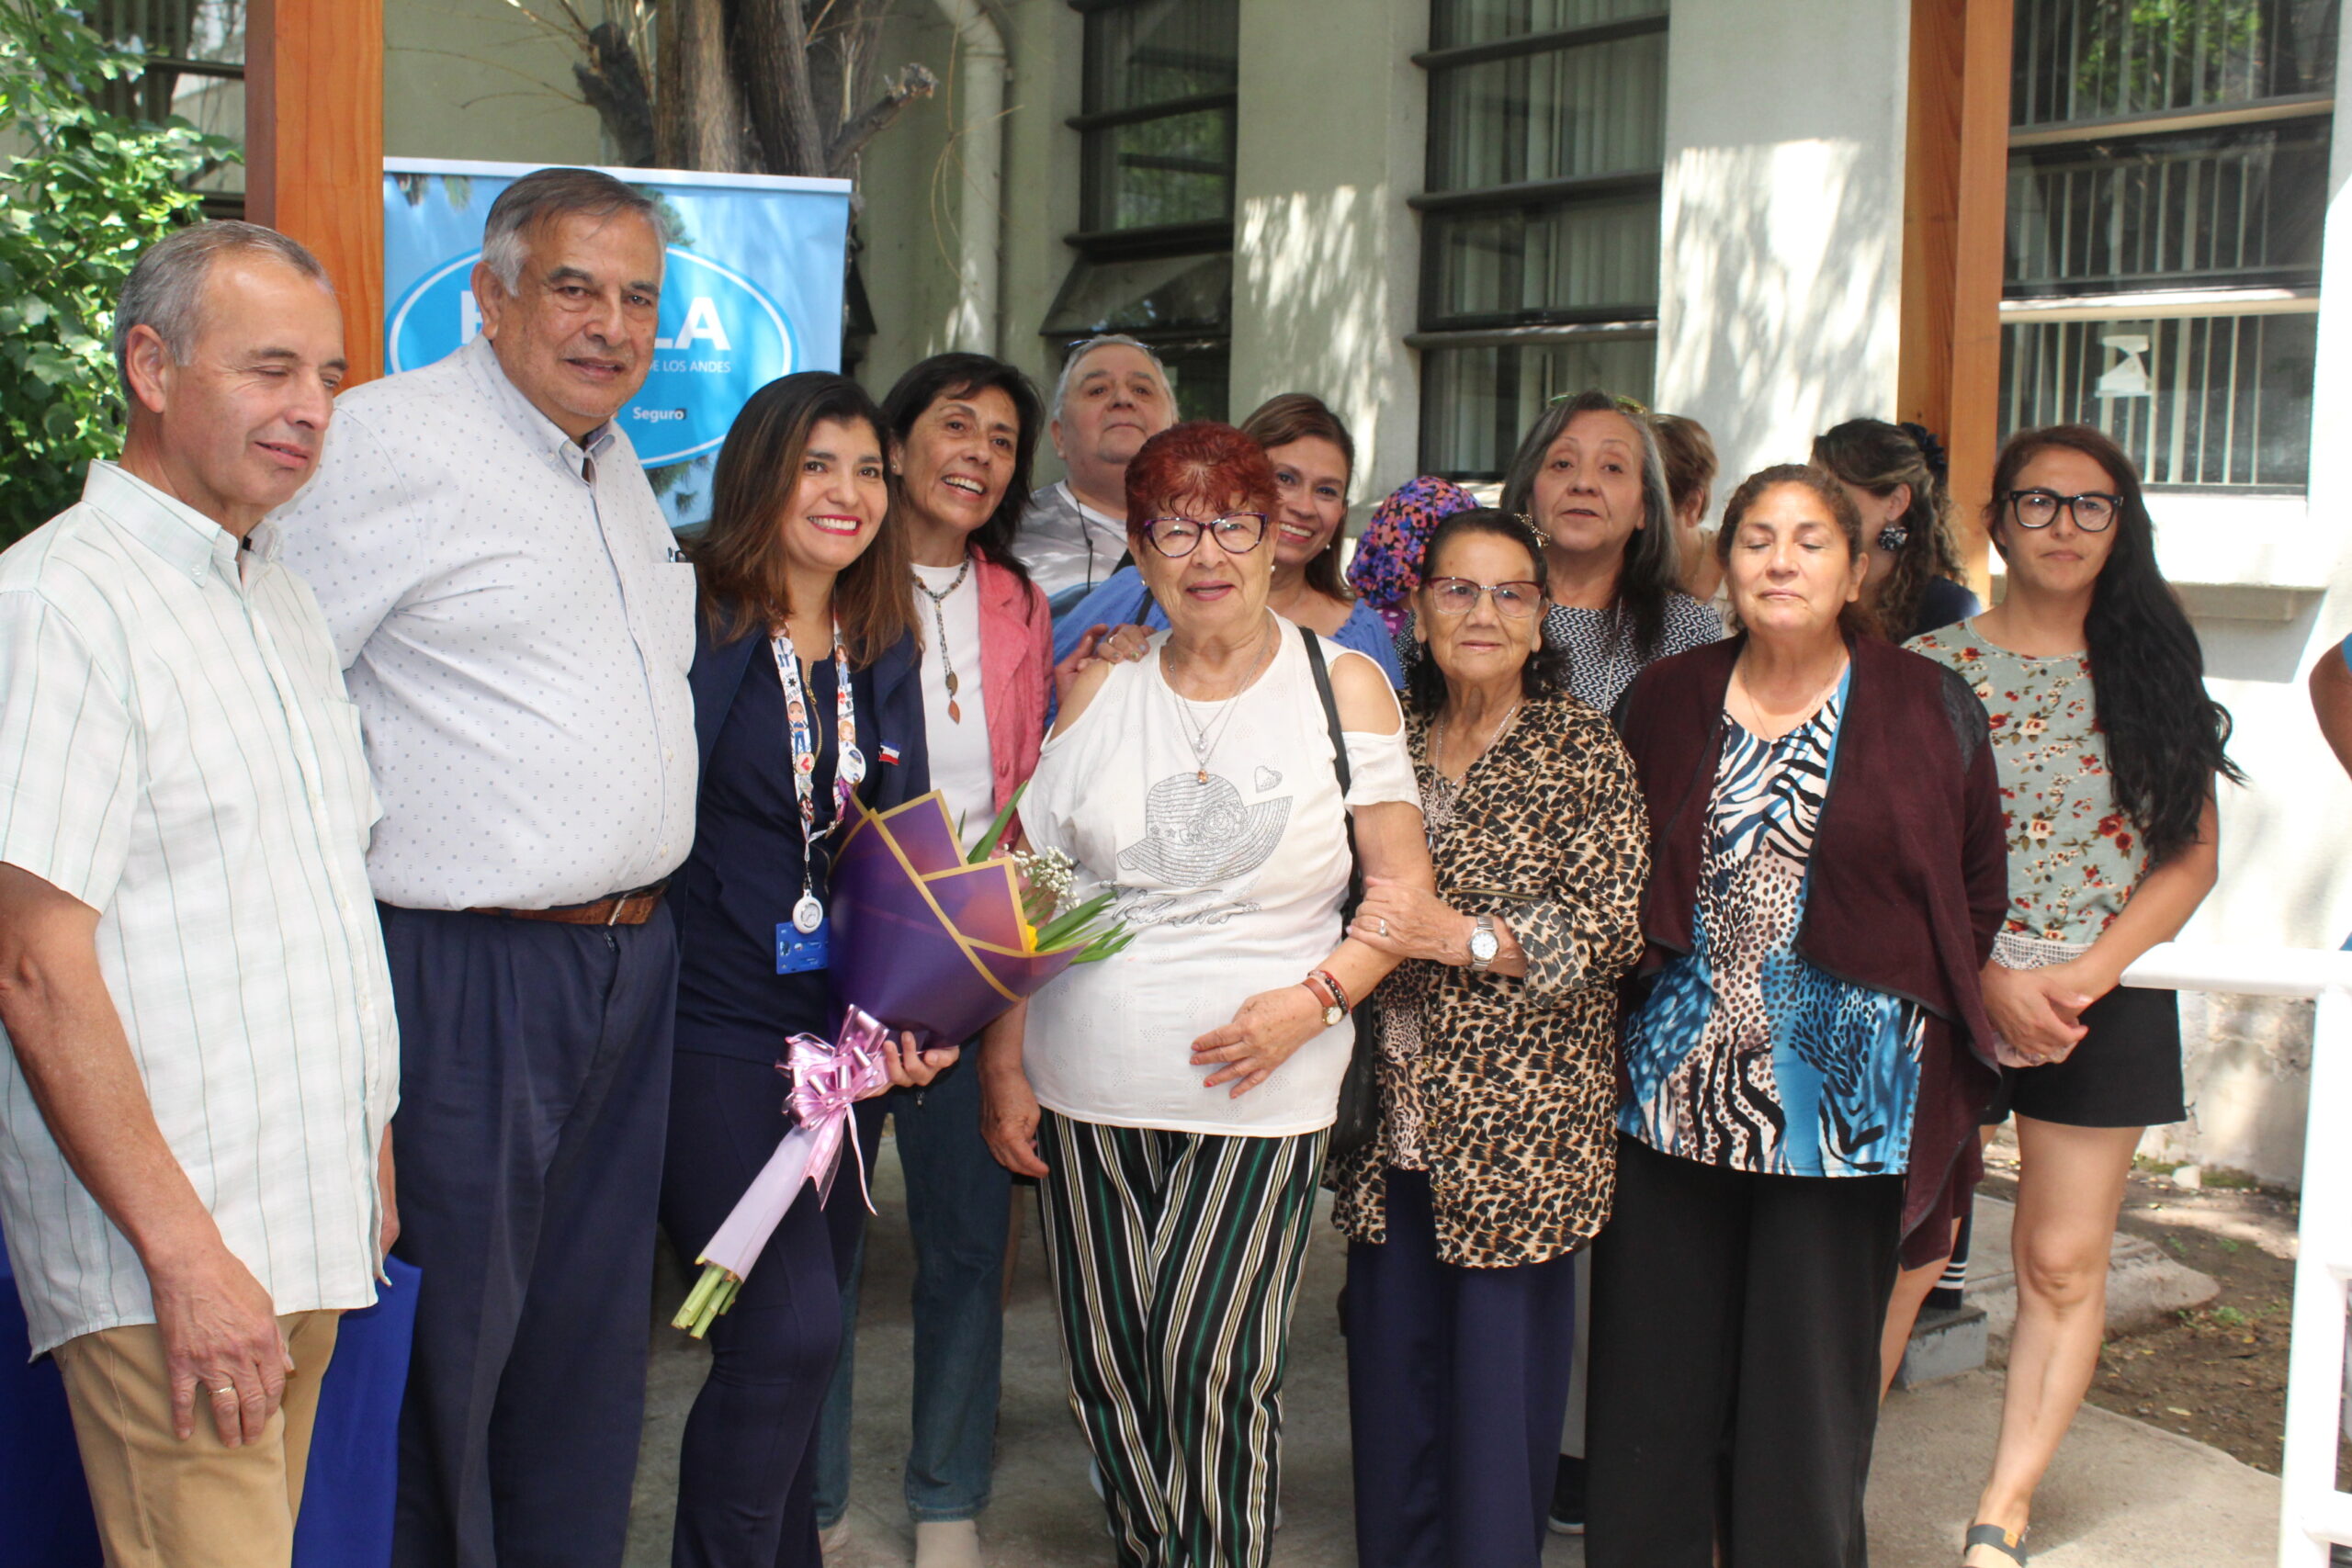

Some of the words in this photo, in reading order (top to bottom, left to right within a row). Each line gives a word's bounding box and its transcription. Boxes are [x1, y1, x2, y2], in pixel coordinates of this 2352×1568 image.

[662, 360, 686, 372] LOS
[689, 361, 731, 373] ANDES
[633, 407, 684, 423] Seguro
